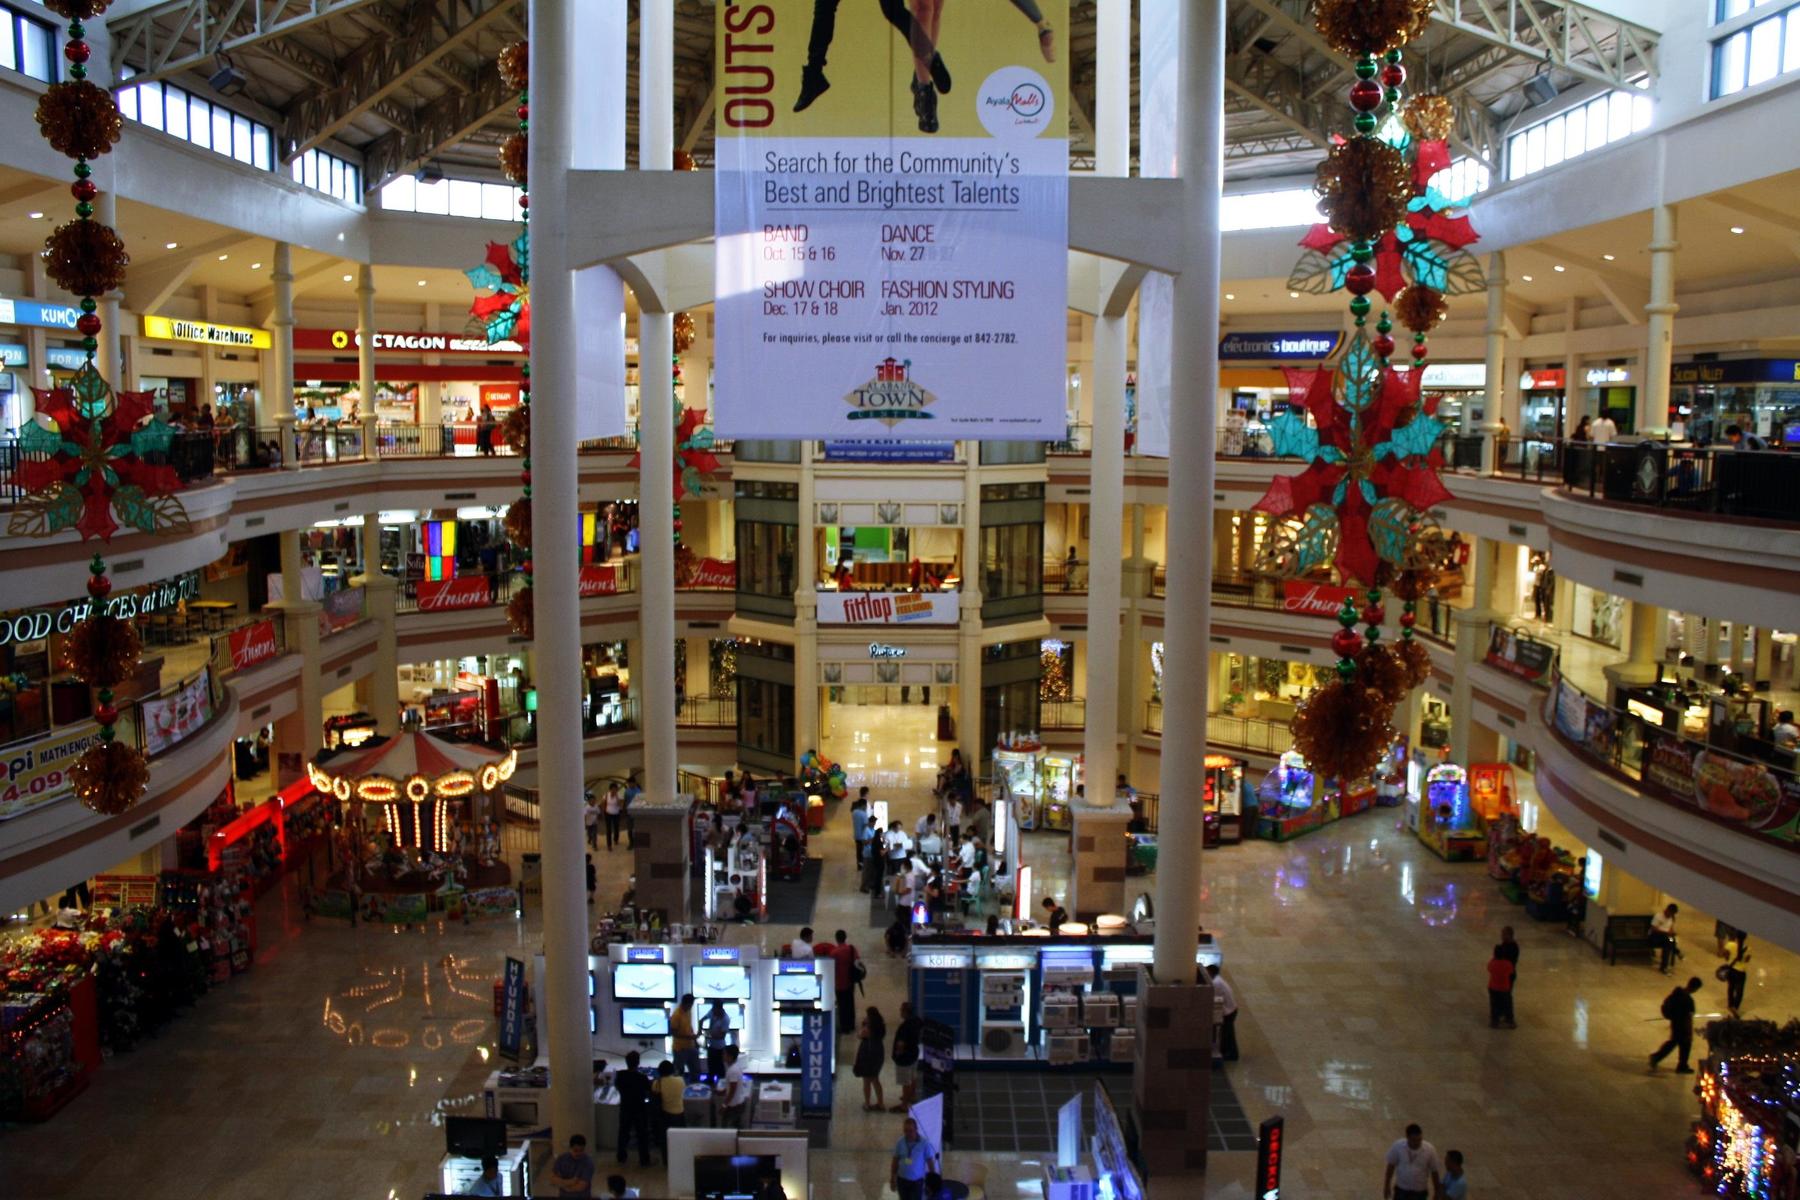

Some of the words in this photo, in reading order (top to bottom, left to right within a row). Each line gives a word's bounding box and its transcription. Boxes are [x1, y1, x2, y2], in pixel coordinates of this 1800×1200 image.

[723, 0, 775, 128] OUTS
[765, 151, 828, 174] Search
[834, 151, 858, 174] for
[865, 151, 893, 174] the
[900, 152, 1020, 178] Community's
[765, 180, 809, 204] Best
[815, 180, 849, 204] and
[857, 180, 944, 209] Brightest
[952, 181, 1020, 205] Talents
[764, 224, 808, 242] BAND
[882, 224, 934, 242] DANCE
[764, 247, 787, 261] Oct.
[791, 246, 805, 261] 15
[808, 247, 817, 260] &
[822, 246, 835, 261] 16
[882, 247, 907, 261] Nov.
[910, 247, 925, 261] 27
[764, 280, 814, 299] SHOW
[819, 280, 865, 299] CHOIR
[882, 280, 948, 299] FASHION
[952, 280, 1014, 300] STYLING
[41, 308, 82, 328] KUMO
[764, 302, 789, 316] Dec.
[794, 302, 807, 316] 17
[811, 302, 820, 316] &
[824, 302, 838, 316] 18
[881, 302, 904, 316] Jan.
[909, 302, 938, 316] 2012
[177, 322, 204, 339] Office
[207, 326, 253, 345] Warehouse
[763, 333, 777, 344] For
[779, 332, 820, 346] inquiries,
[822, 332, 851, 346] please
[853, 332, 872, 344] visit
[875, 335, 884, 344] or
[886, 332, 901, 344] call
[904, 332, 918, 344] the
[920, 333, 961, 346] concierge
[964, 334, 973, 344] at
[1223, 339, 1280, 353] electronics
[1281, 338, 1330, 356] boutique
[854, 389, 926, 408] TOWN
[57, 593, 138, 633] CHICES
[142, 591, 156, 613] at
[160, 584, 176, 607] the
[843, 591, 892, 623] fitflop
[505, 961, 519, 1045] HYUNDAI
[809, 1015, 822, 1104] HYUNDAI
